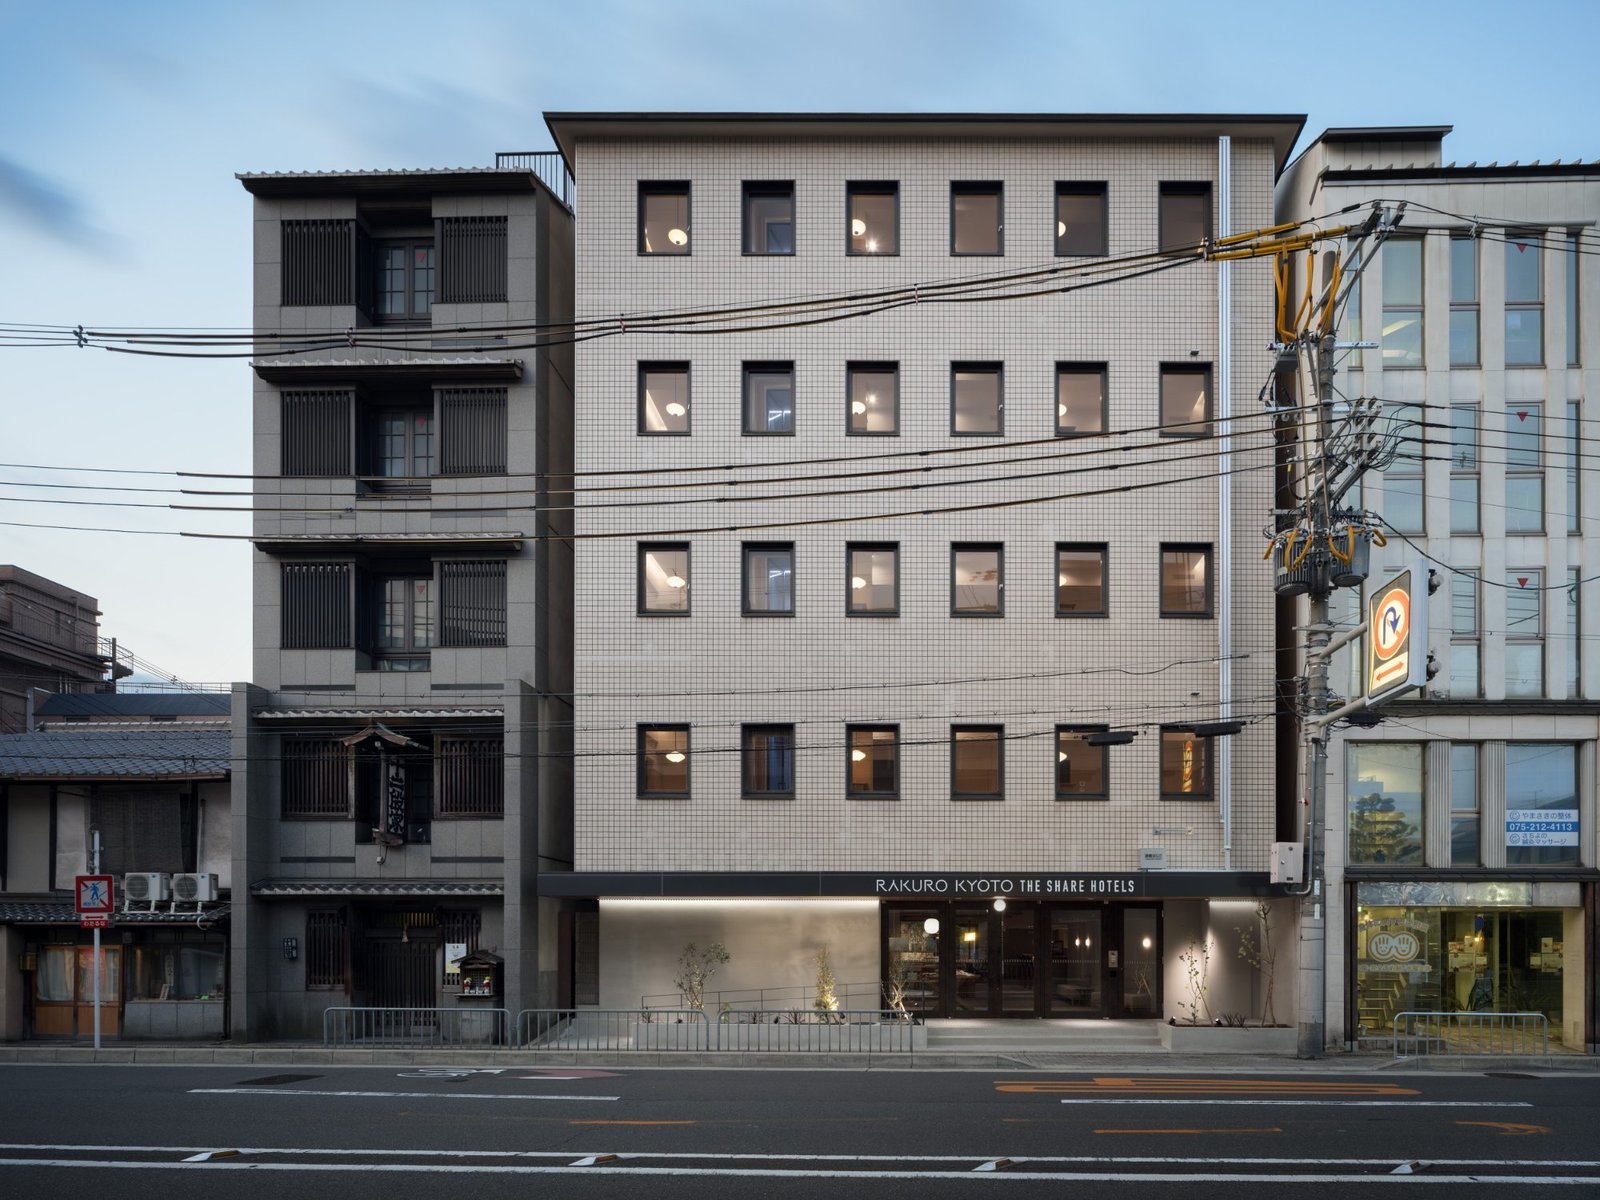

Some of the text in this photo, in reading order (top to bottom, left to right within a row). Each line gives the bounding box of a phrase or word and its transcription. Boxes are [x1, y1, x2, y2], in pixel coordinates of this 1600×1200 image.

[1509, 823, 1572, 831] 075-212-4113
[876, 879, 1135, 893] RAKURO KYOTO THE SHARE HOTELS
